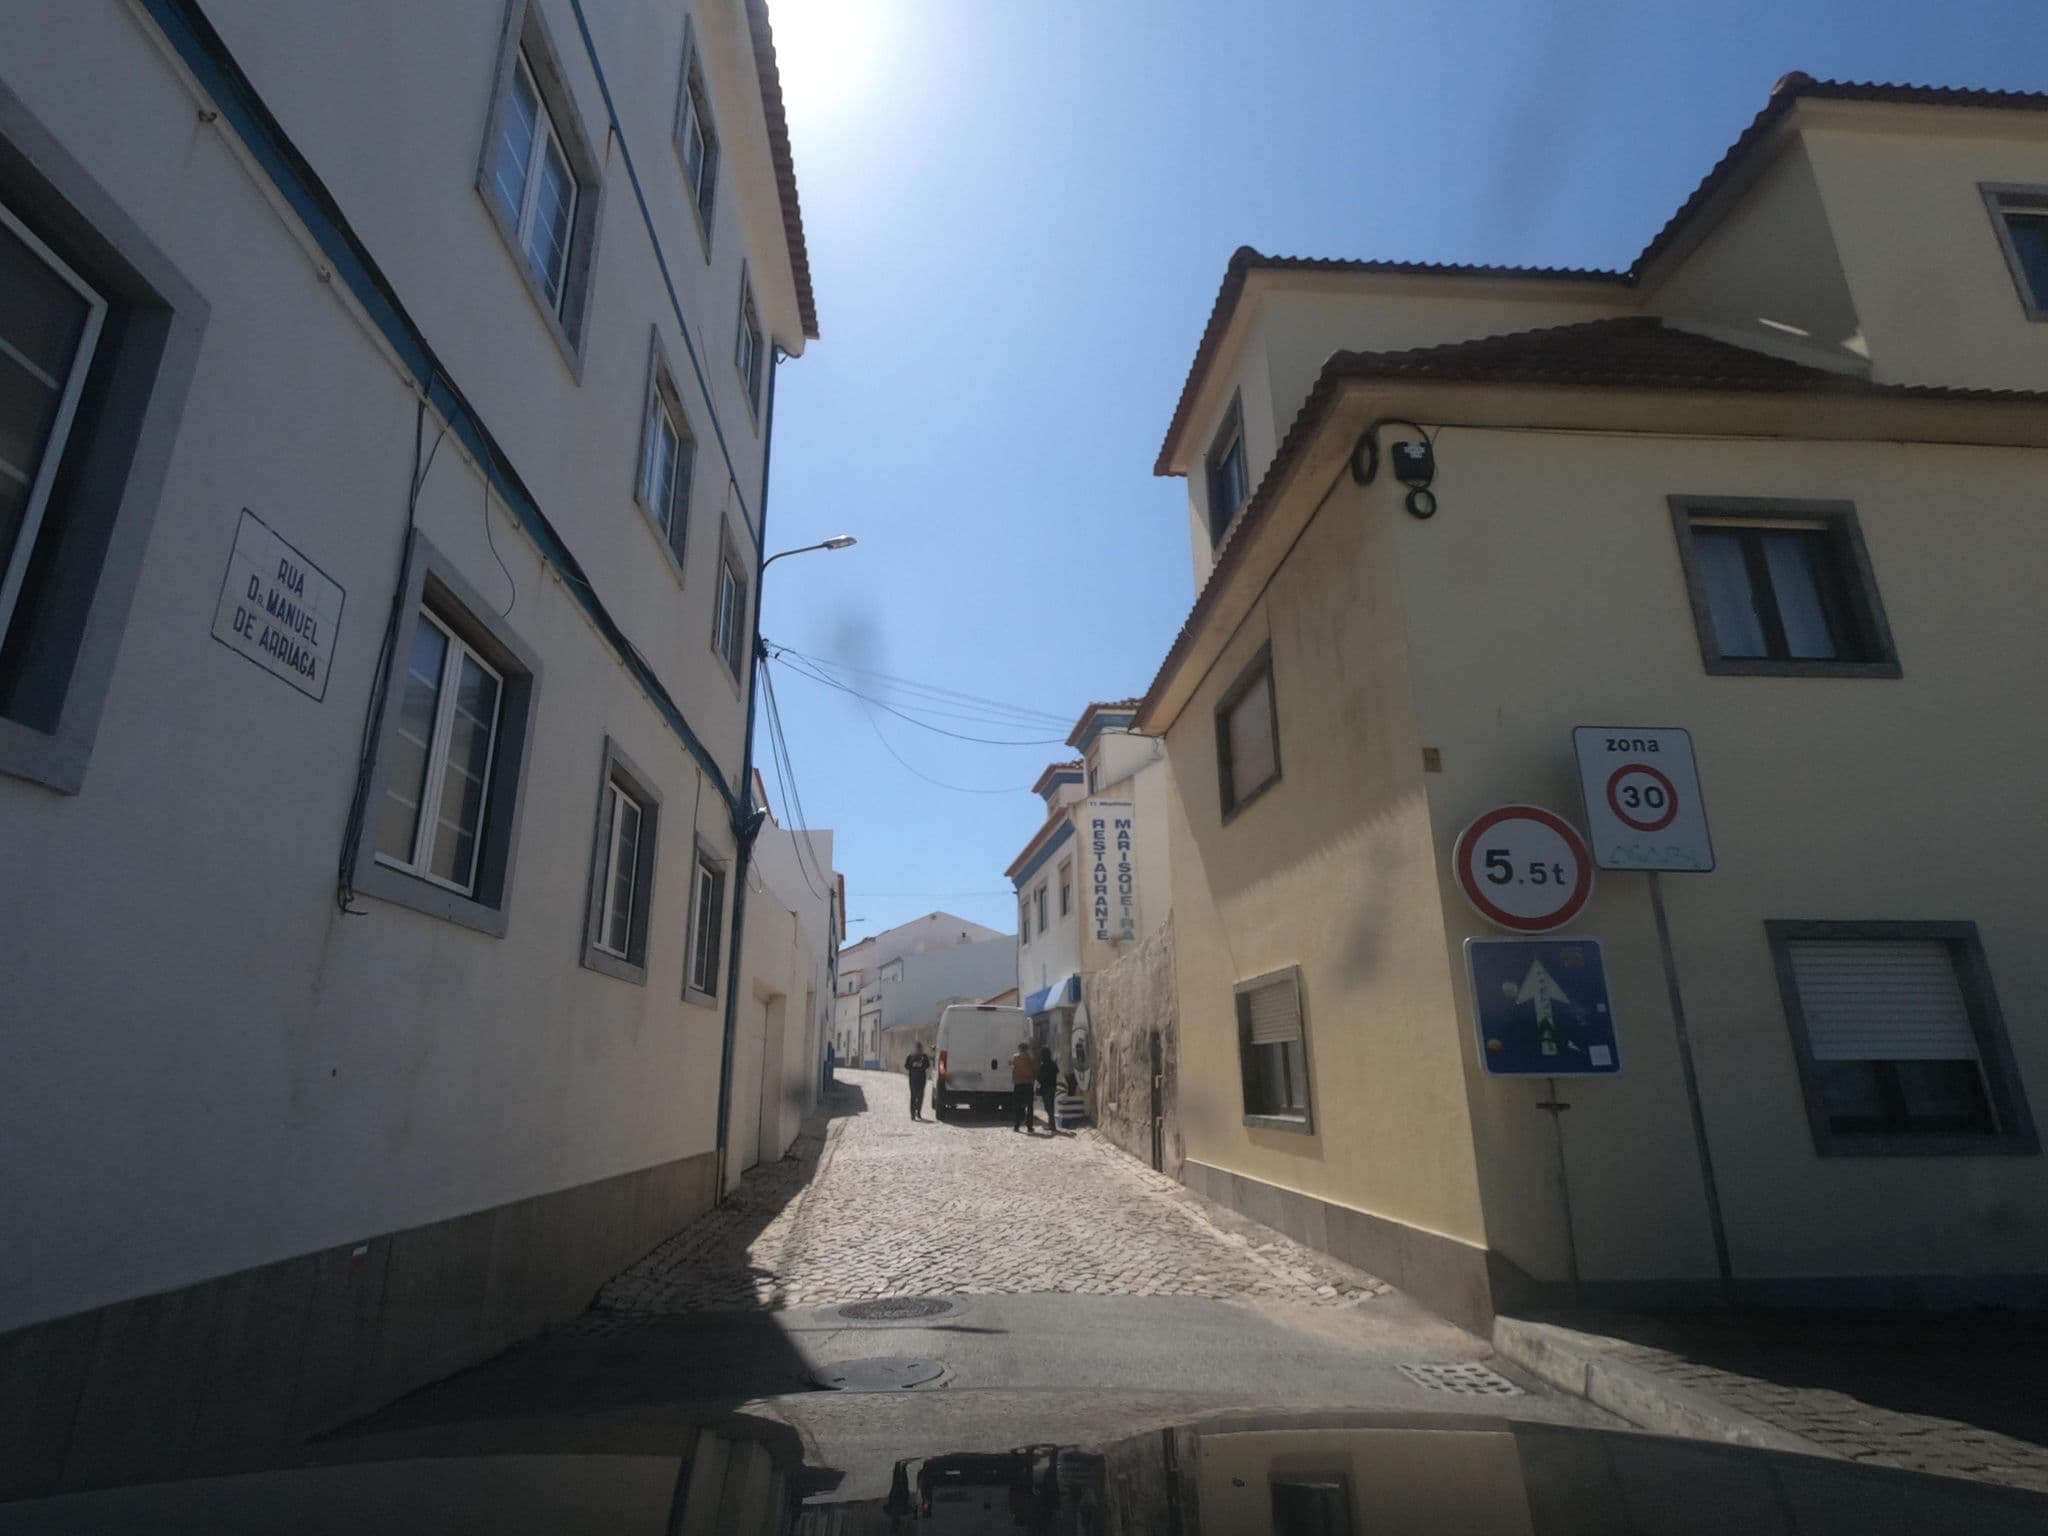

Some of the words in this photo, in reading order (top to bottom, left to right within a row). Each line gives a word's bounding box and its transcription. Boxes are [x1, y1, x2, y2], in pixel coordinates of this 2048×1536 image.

[277, 557, 305, 598] RUA
[233, 606, 257, 640] DE
[259, 626, 316, 680] ARRIAGA
[266, 588, 318, 646] MANUEL
[1606, 738, 1660, 752] zona
[1622, 786, 1665, 808] 30
[1092, 819, 1109, 940] RESTAURANTE
[1115, 819, 1135, 940] MARISQUEIRA
